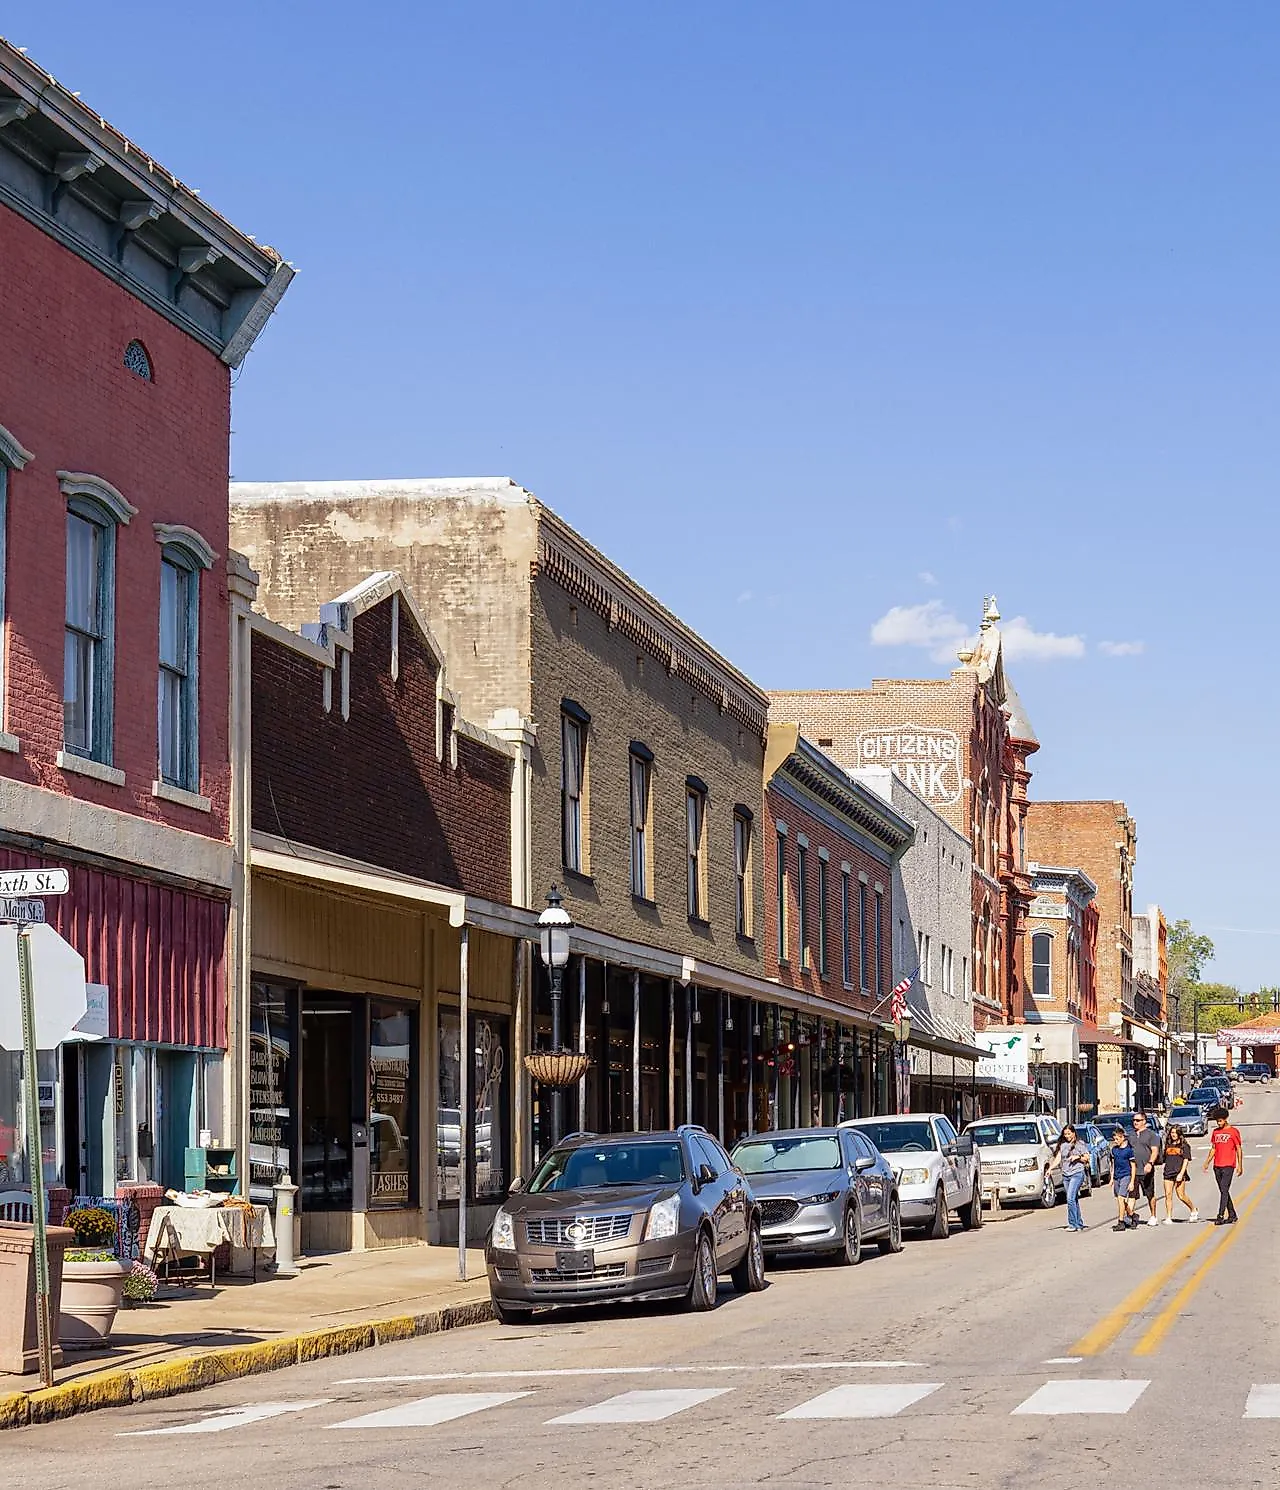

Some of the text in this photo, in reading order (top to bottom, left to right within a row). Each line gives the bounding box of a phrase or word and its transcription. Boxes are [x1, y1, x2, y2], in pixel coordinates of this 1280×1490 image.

[863, 735, 955, 760] CITIZENS
[0, 873, 55, 891] ixth St.
[3, 900, 26, 919] Main
[979, 1064, 1025, 1073] POINTER
[115, 1066, 123, 1113] OPEN
[371, 1174, 409, 1196] LASHES
